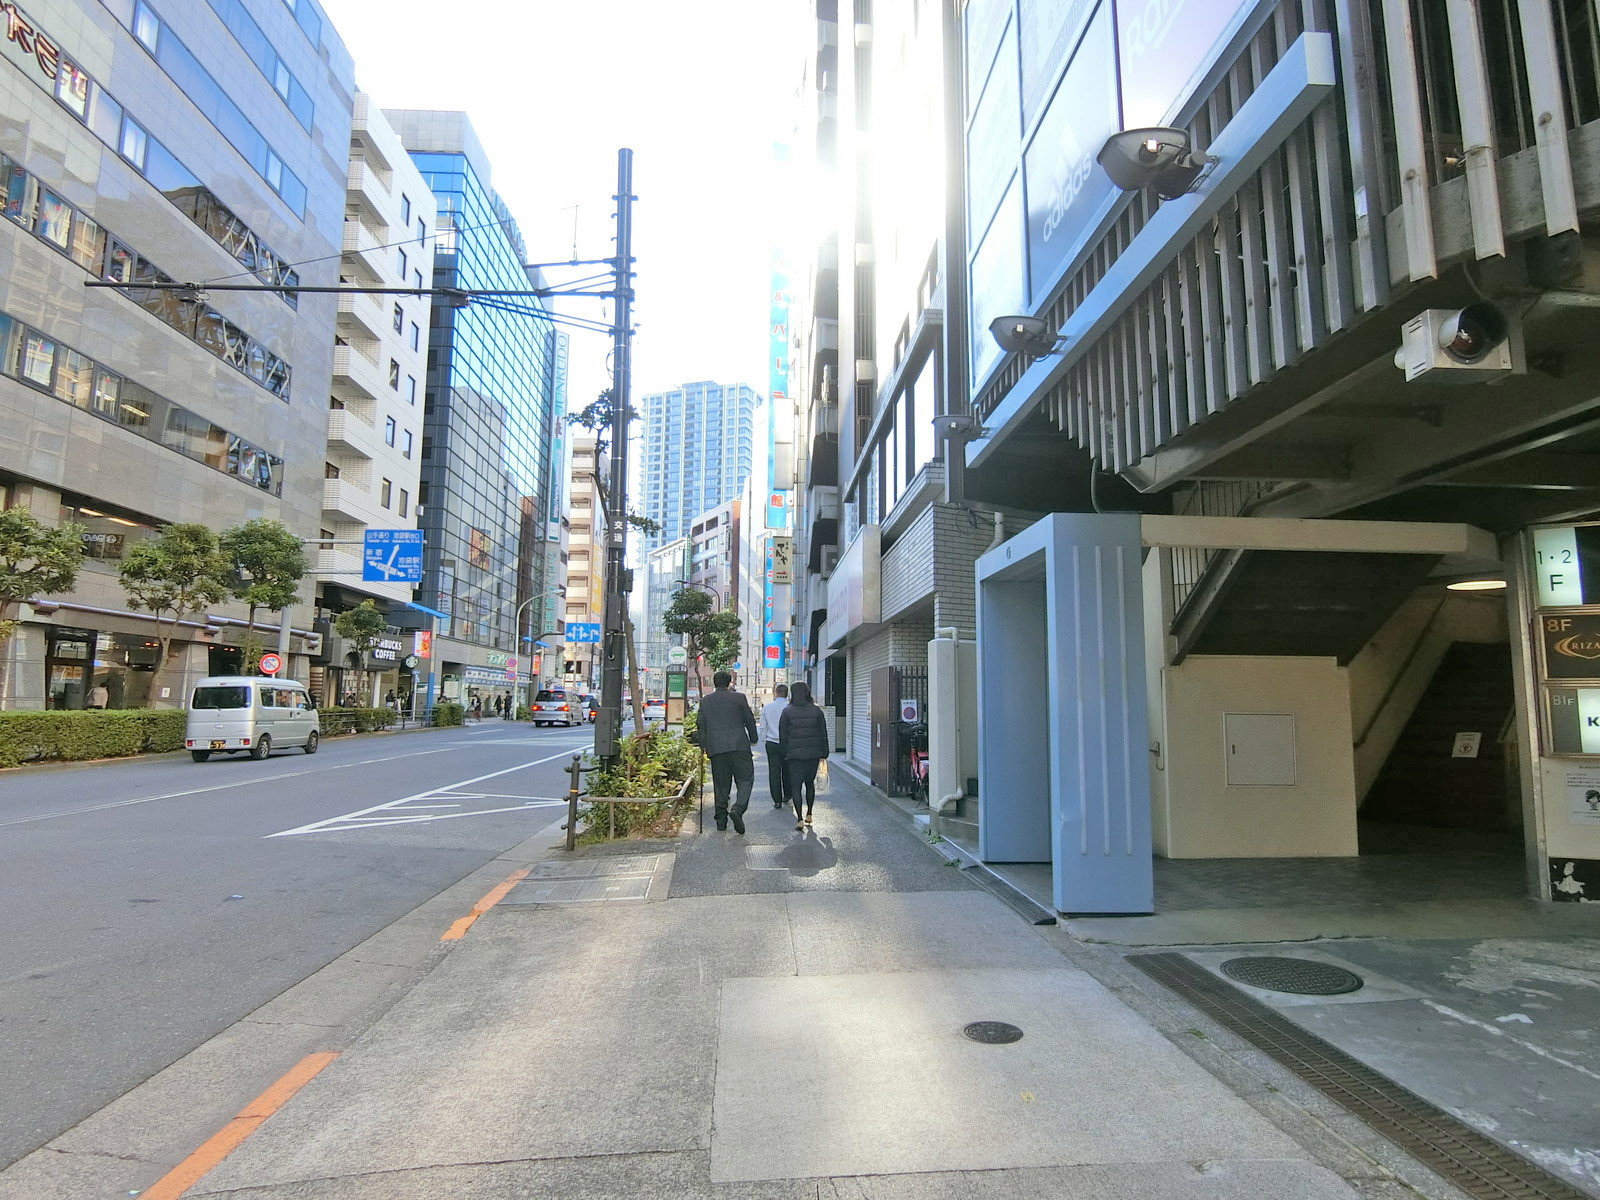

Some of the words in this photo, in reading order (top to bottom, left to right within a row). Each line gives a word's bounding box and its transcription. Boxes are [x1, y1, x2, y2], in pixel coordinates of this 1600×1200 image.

[1043, 151, 1092, 242] adidas
[555, 335, 567, 411] JUNKUDO
[613, 520, 623, 543] 交通
[1550, 574, 1563, 591] F
[1547, 619, 1572, 632] 8F
[375, 649, 396, 660] COFFEE
